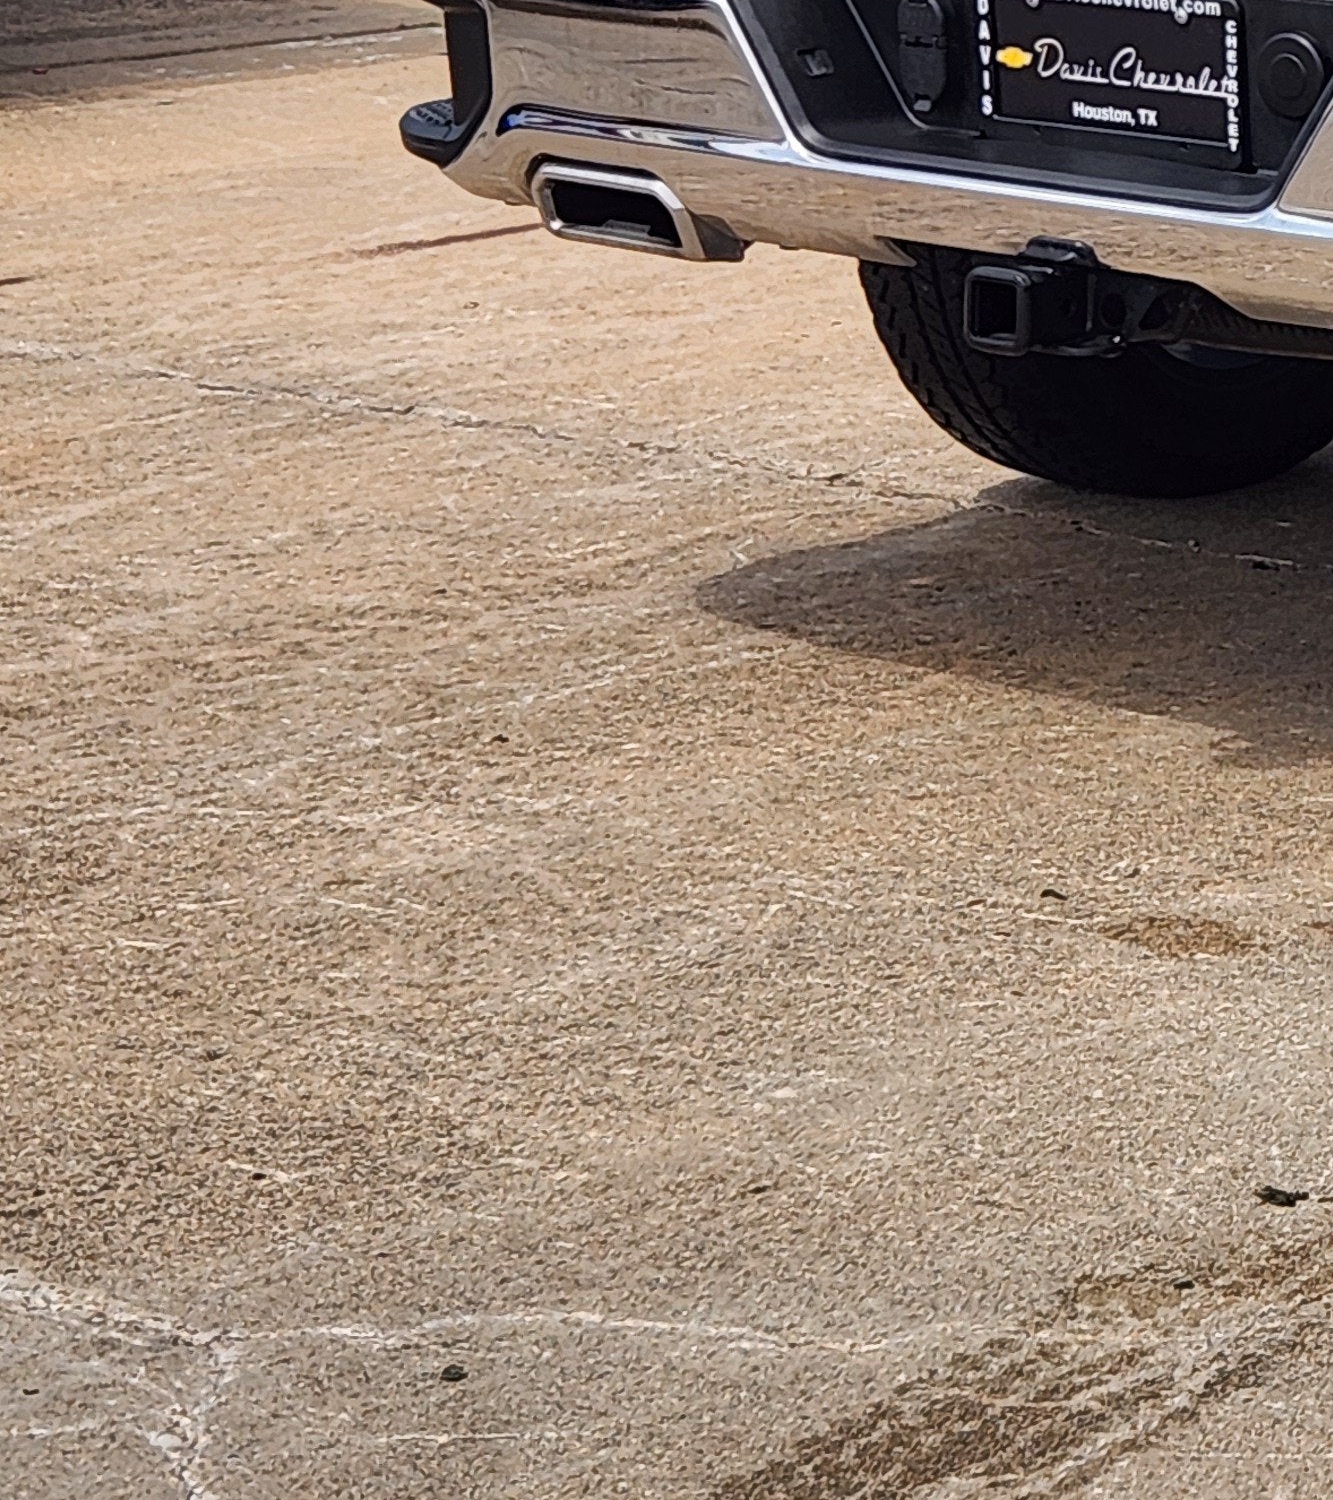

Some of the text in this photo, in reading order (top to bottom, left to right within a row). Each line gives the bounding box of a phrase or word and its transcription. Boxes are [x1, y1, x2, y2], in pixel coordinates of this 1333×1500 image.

[1033, 37, 1109, 83] Davis
[1224, 18, 1240, 153] CHEVROLET
[1072, 100, 1159, 127] Houston, TX
